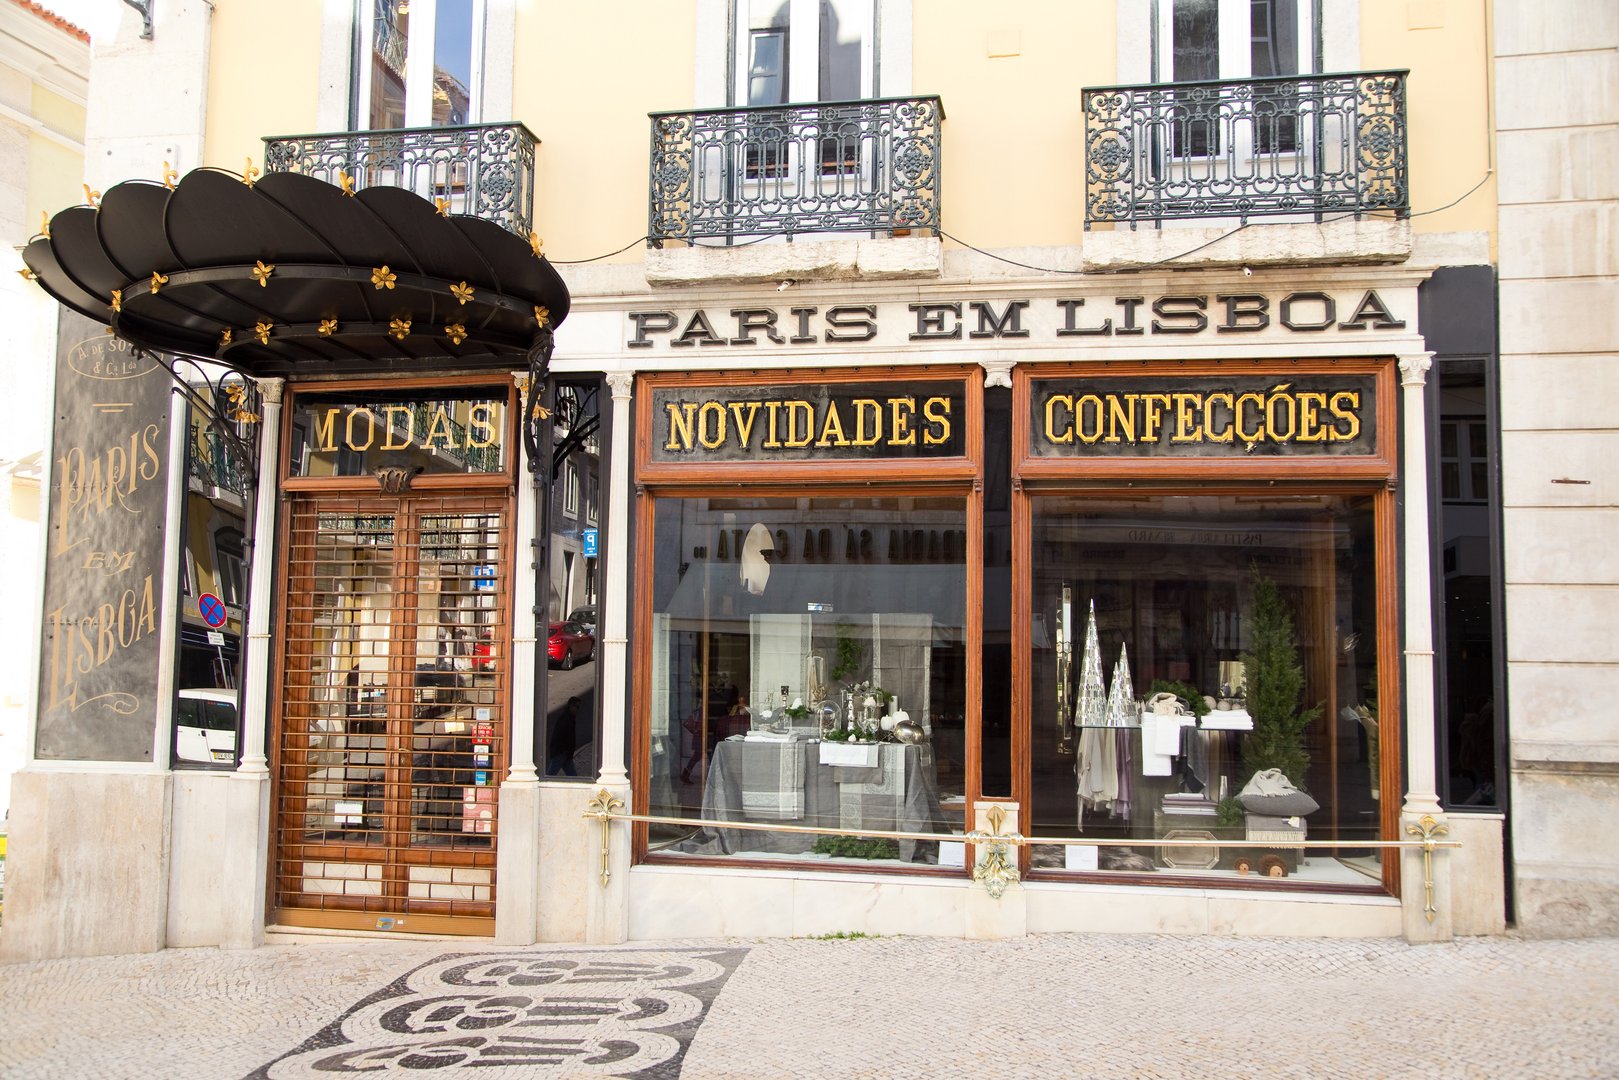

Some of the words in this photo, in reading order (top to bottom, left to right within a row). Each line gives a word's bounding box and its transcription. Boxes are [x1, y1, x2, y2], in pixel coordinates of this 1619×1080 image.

[627, 304, 878, 348] PARIS
[908, 299, 1030, 340] EM
[1056, 289, 1406, 336] LISBOA
[306, 403, 497, 452] MODAS
[664, 396, 951, 450] NOVIDADES
[53, 424, 160, 559] PARIS
[80, 551, 136, 576] EM
[44, 574, 156, 714] LISBOA
